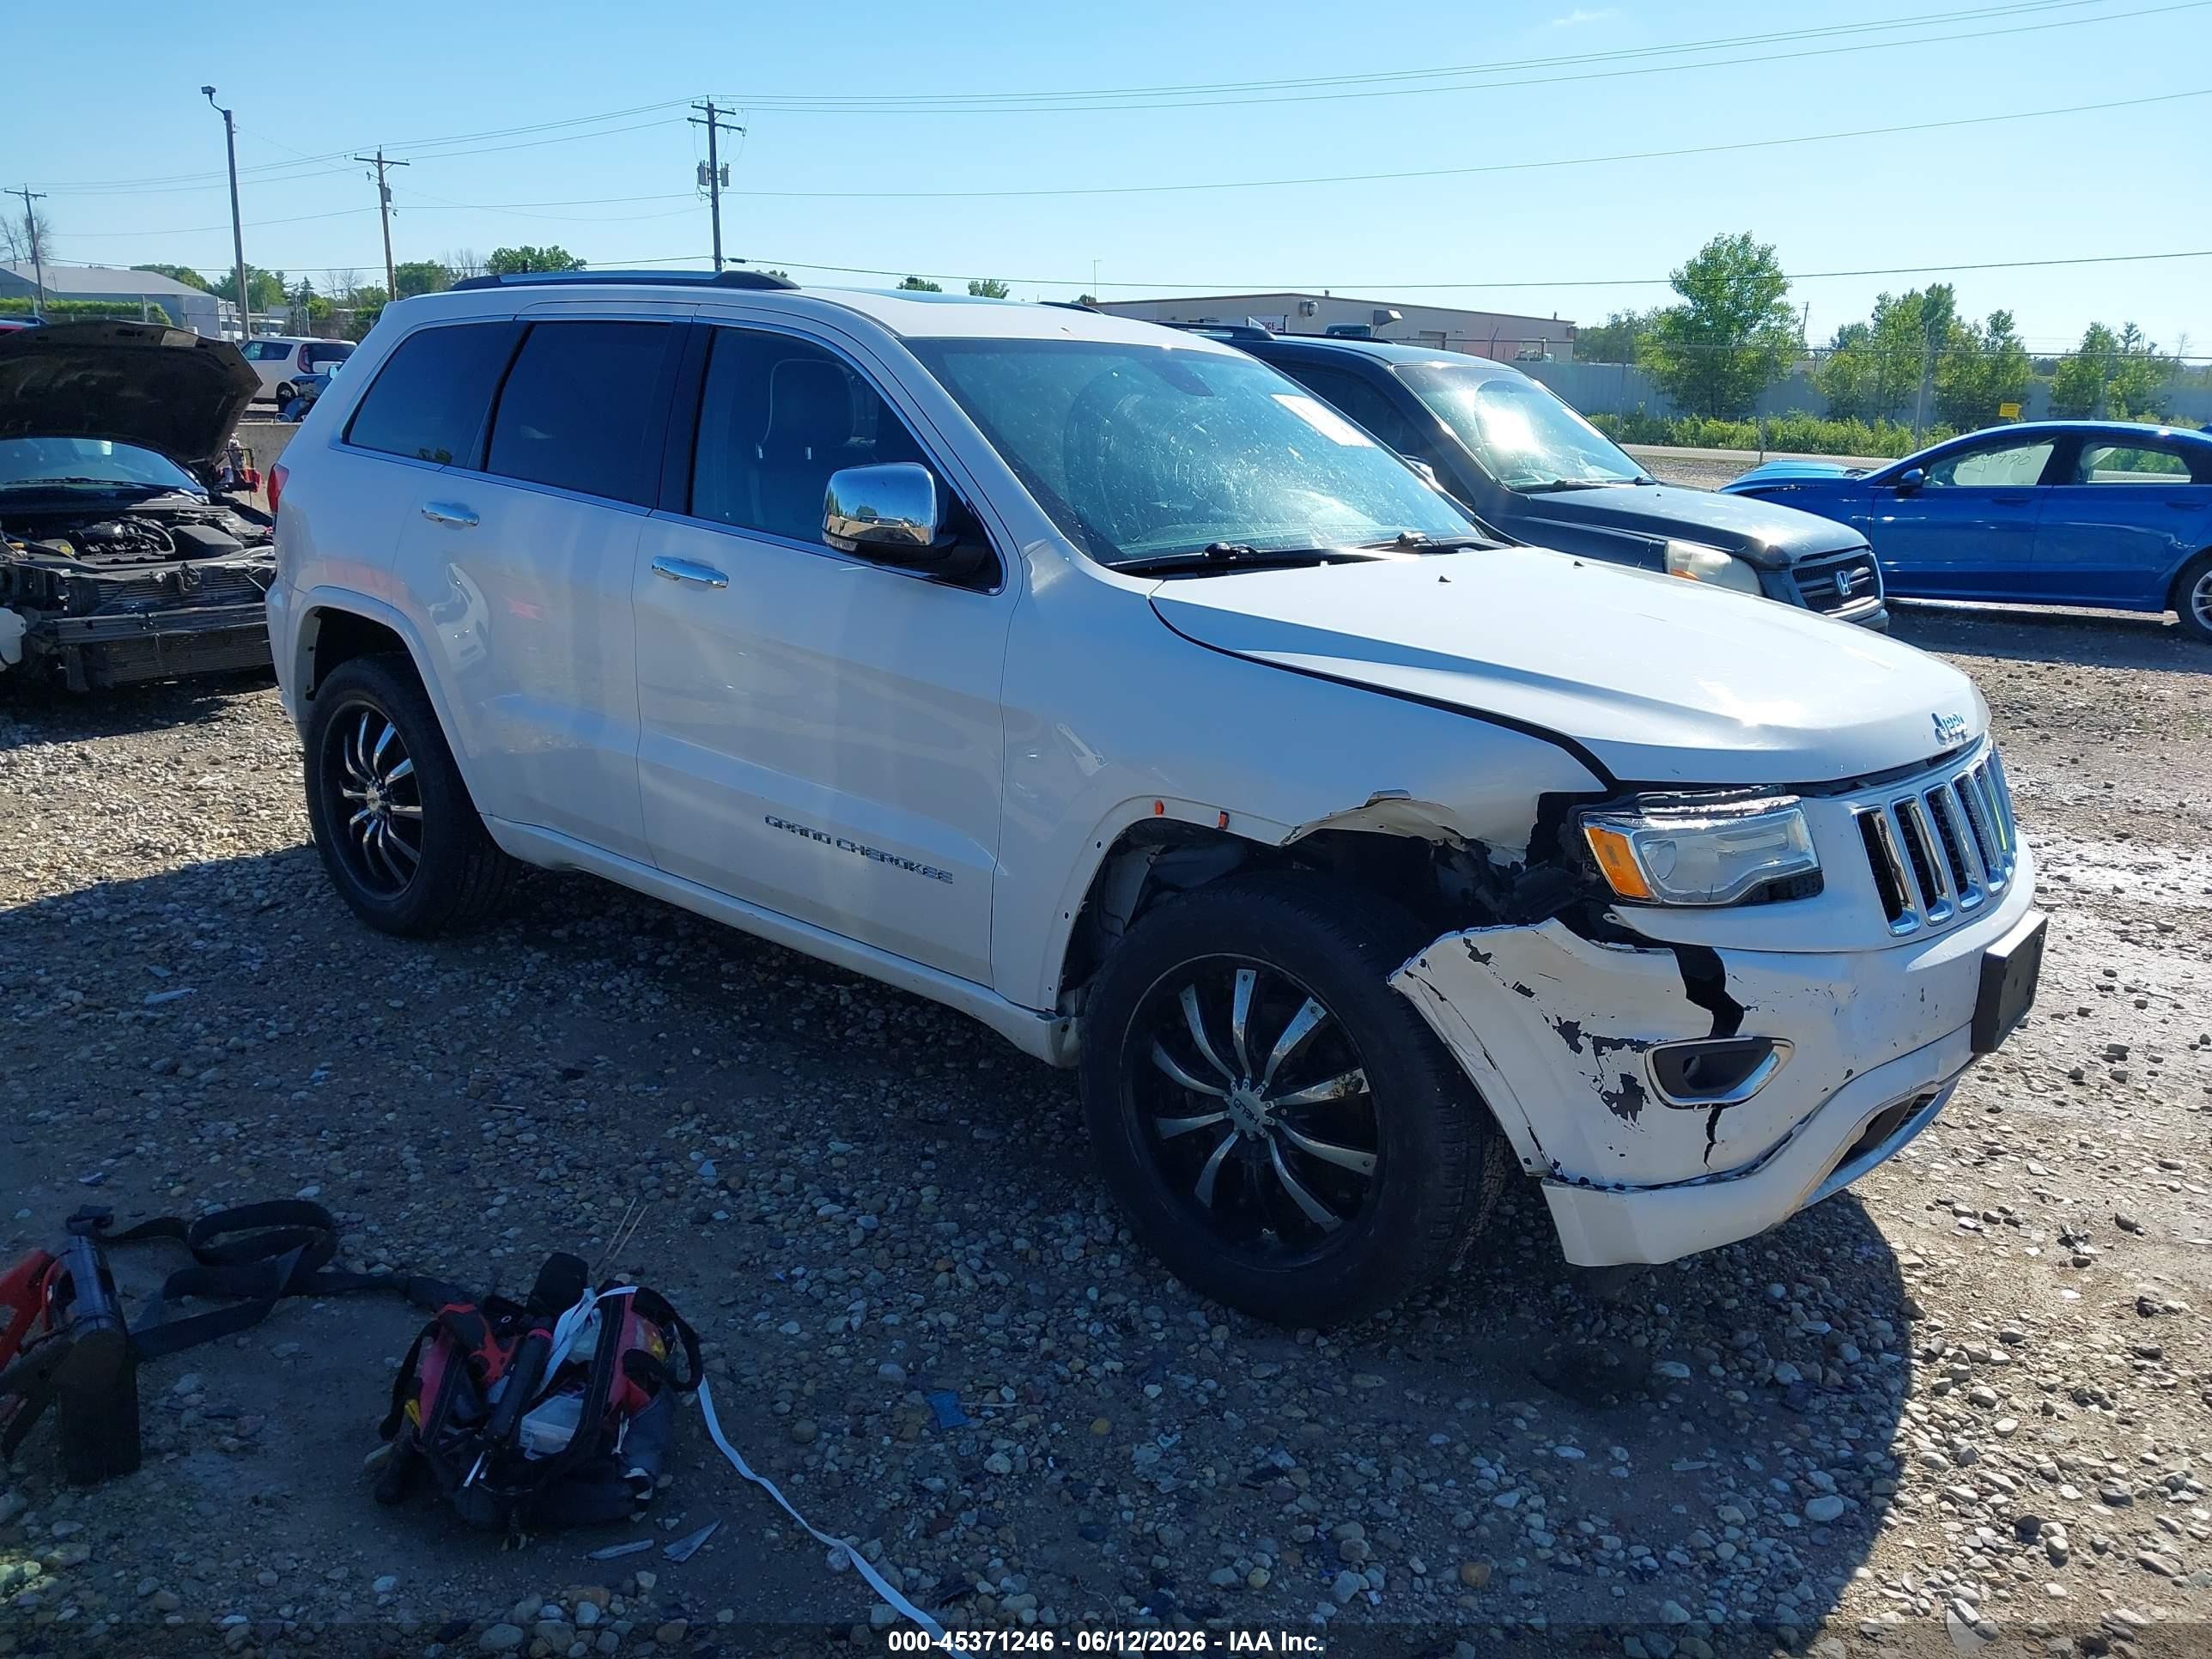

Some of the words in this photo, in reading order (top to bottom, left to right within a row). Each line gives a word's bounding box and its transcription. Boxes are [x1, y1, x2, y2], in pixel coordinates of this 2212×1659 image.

[764, 814, 832, 845] GRAND
[836, 837, 954, 884] CHEROKEE
[1233, 1098, 1260, 1125] HELO
